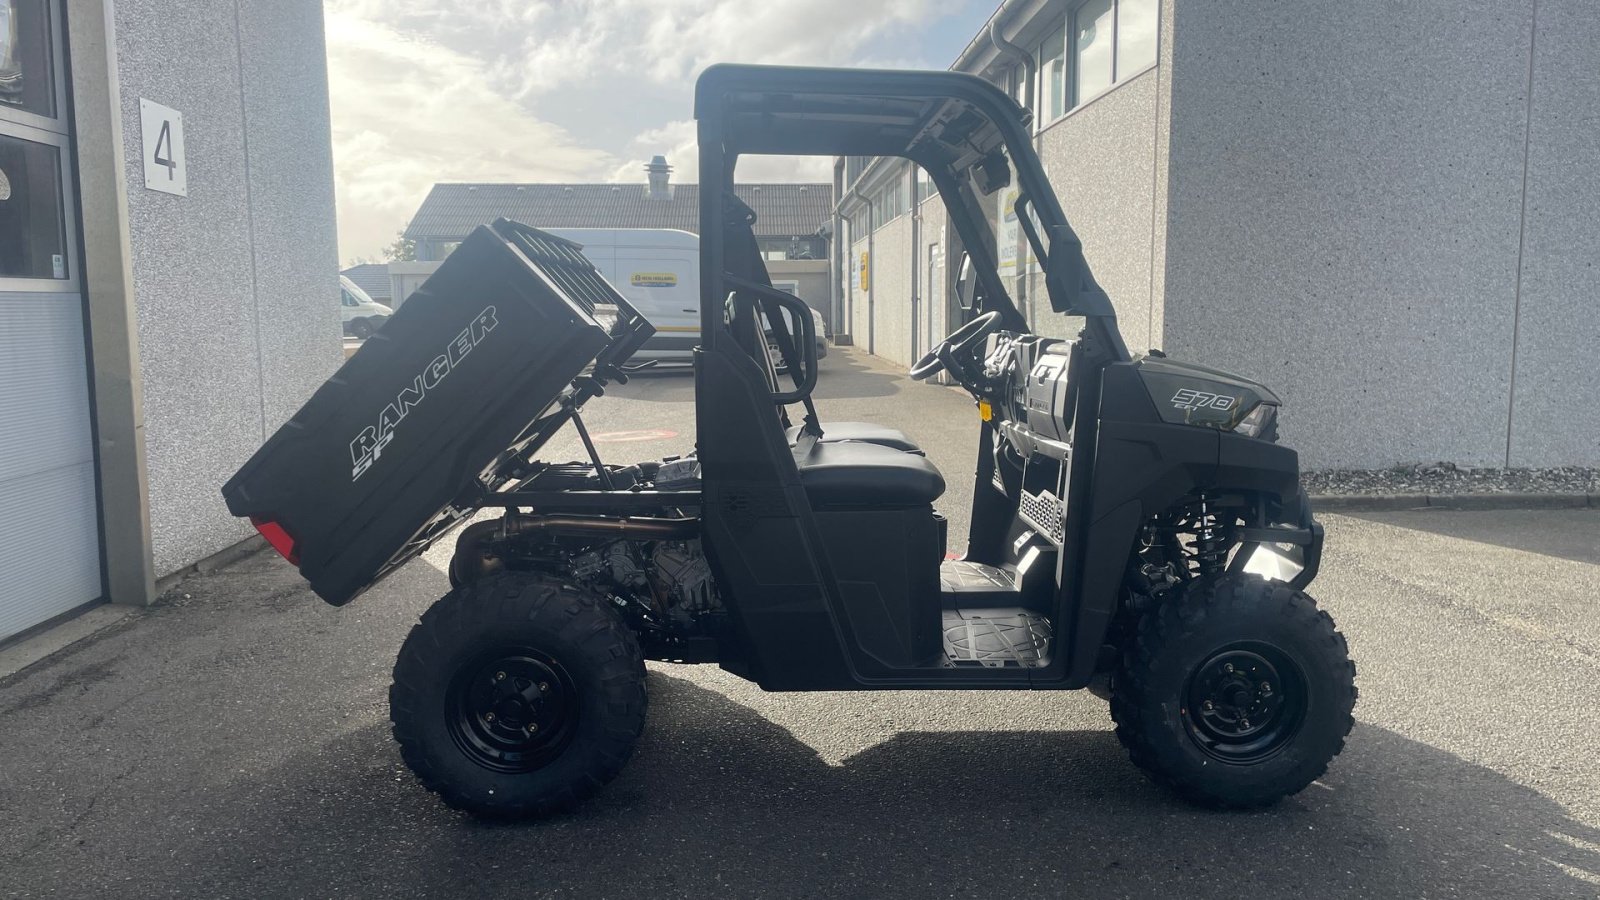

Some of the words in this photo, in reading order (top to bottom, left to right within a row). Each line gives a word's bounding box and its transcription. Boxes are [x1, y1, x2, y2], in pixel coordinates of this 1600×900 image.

[154, 120, 177, 181] 4
[350, 305, 499, 466] RANGER
[1170, 388, 1235, 411] 570
[352, 430, 395, 483] SP
